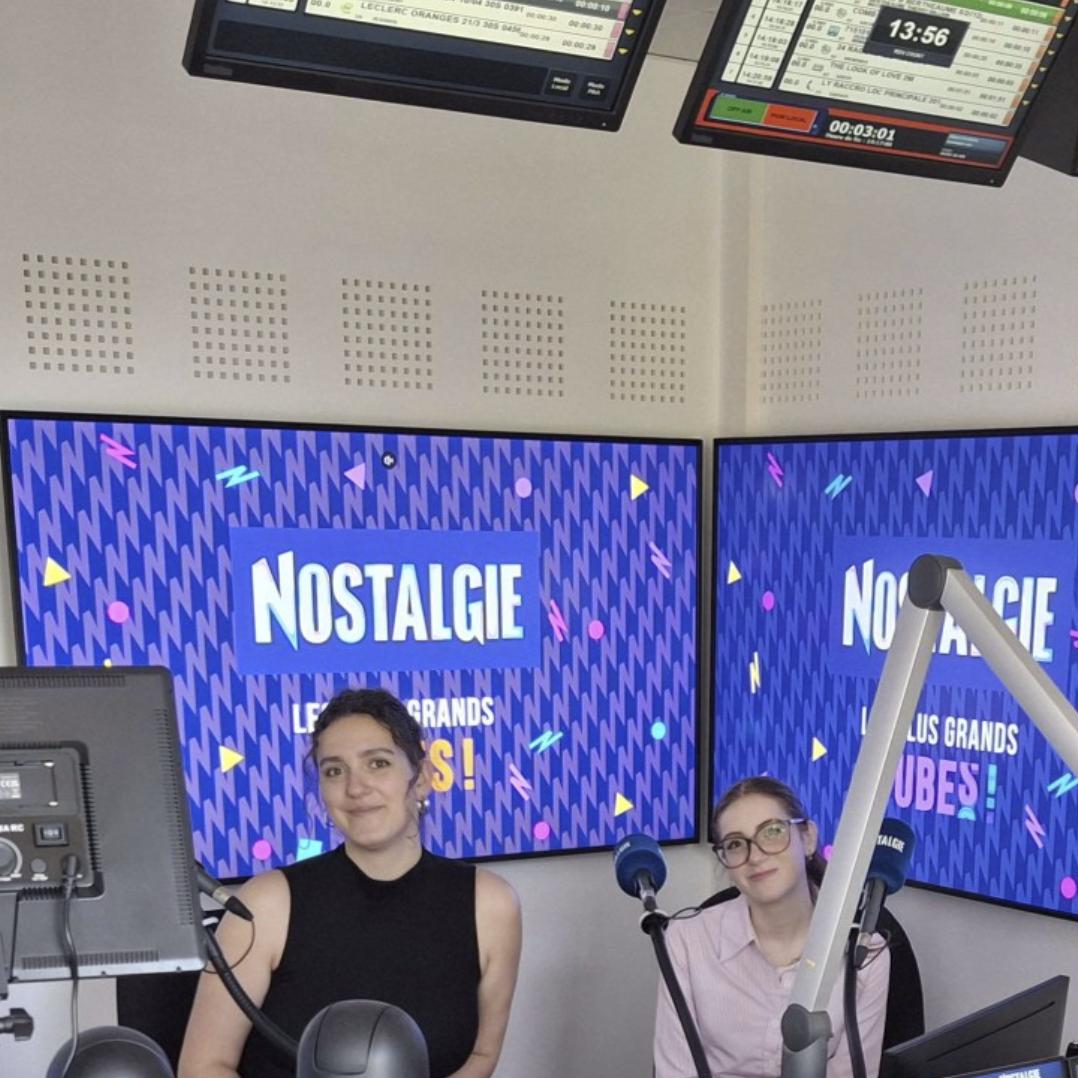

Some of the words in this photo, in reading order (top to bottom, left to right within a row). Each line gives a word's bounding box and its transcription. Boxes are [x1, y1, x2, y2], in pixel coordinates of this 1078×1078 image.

[360, 2, 408, 16] LECLERC
[411, 9, 459, 23] ORANGES
[887, 18, 949, 47] 13:56
[828, 118, 895, 142] 00:03:01
[252, 550, 524, 650] NOSTALGIE
[293, 701, 327, 734] LE
[409, 697, 495, 728] GRANDS
[907, 714, 938, 745] LUS
[944, 719, 1019, 756] GRANDS
[893, 754, 980, 816] UBES
